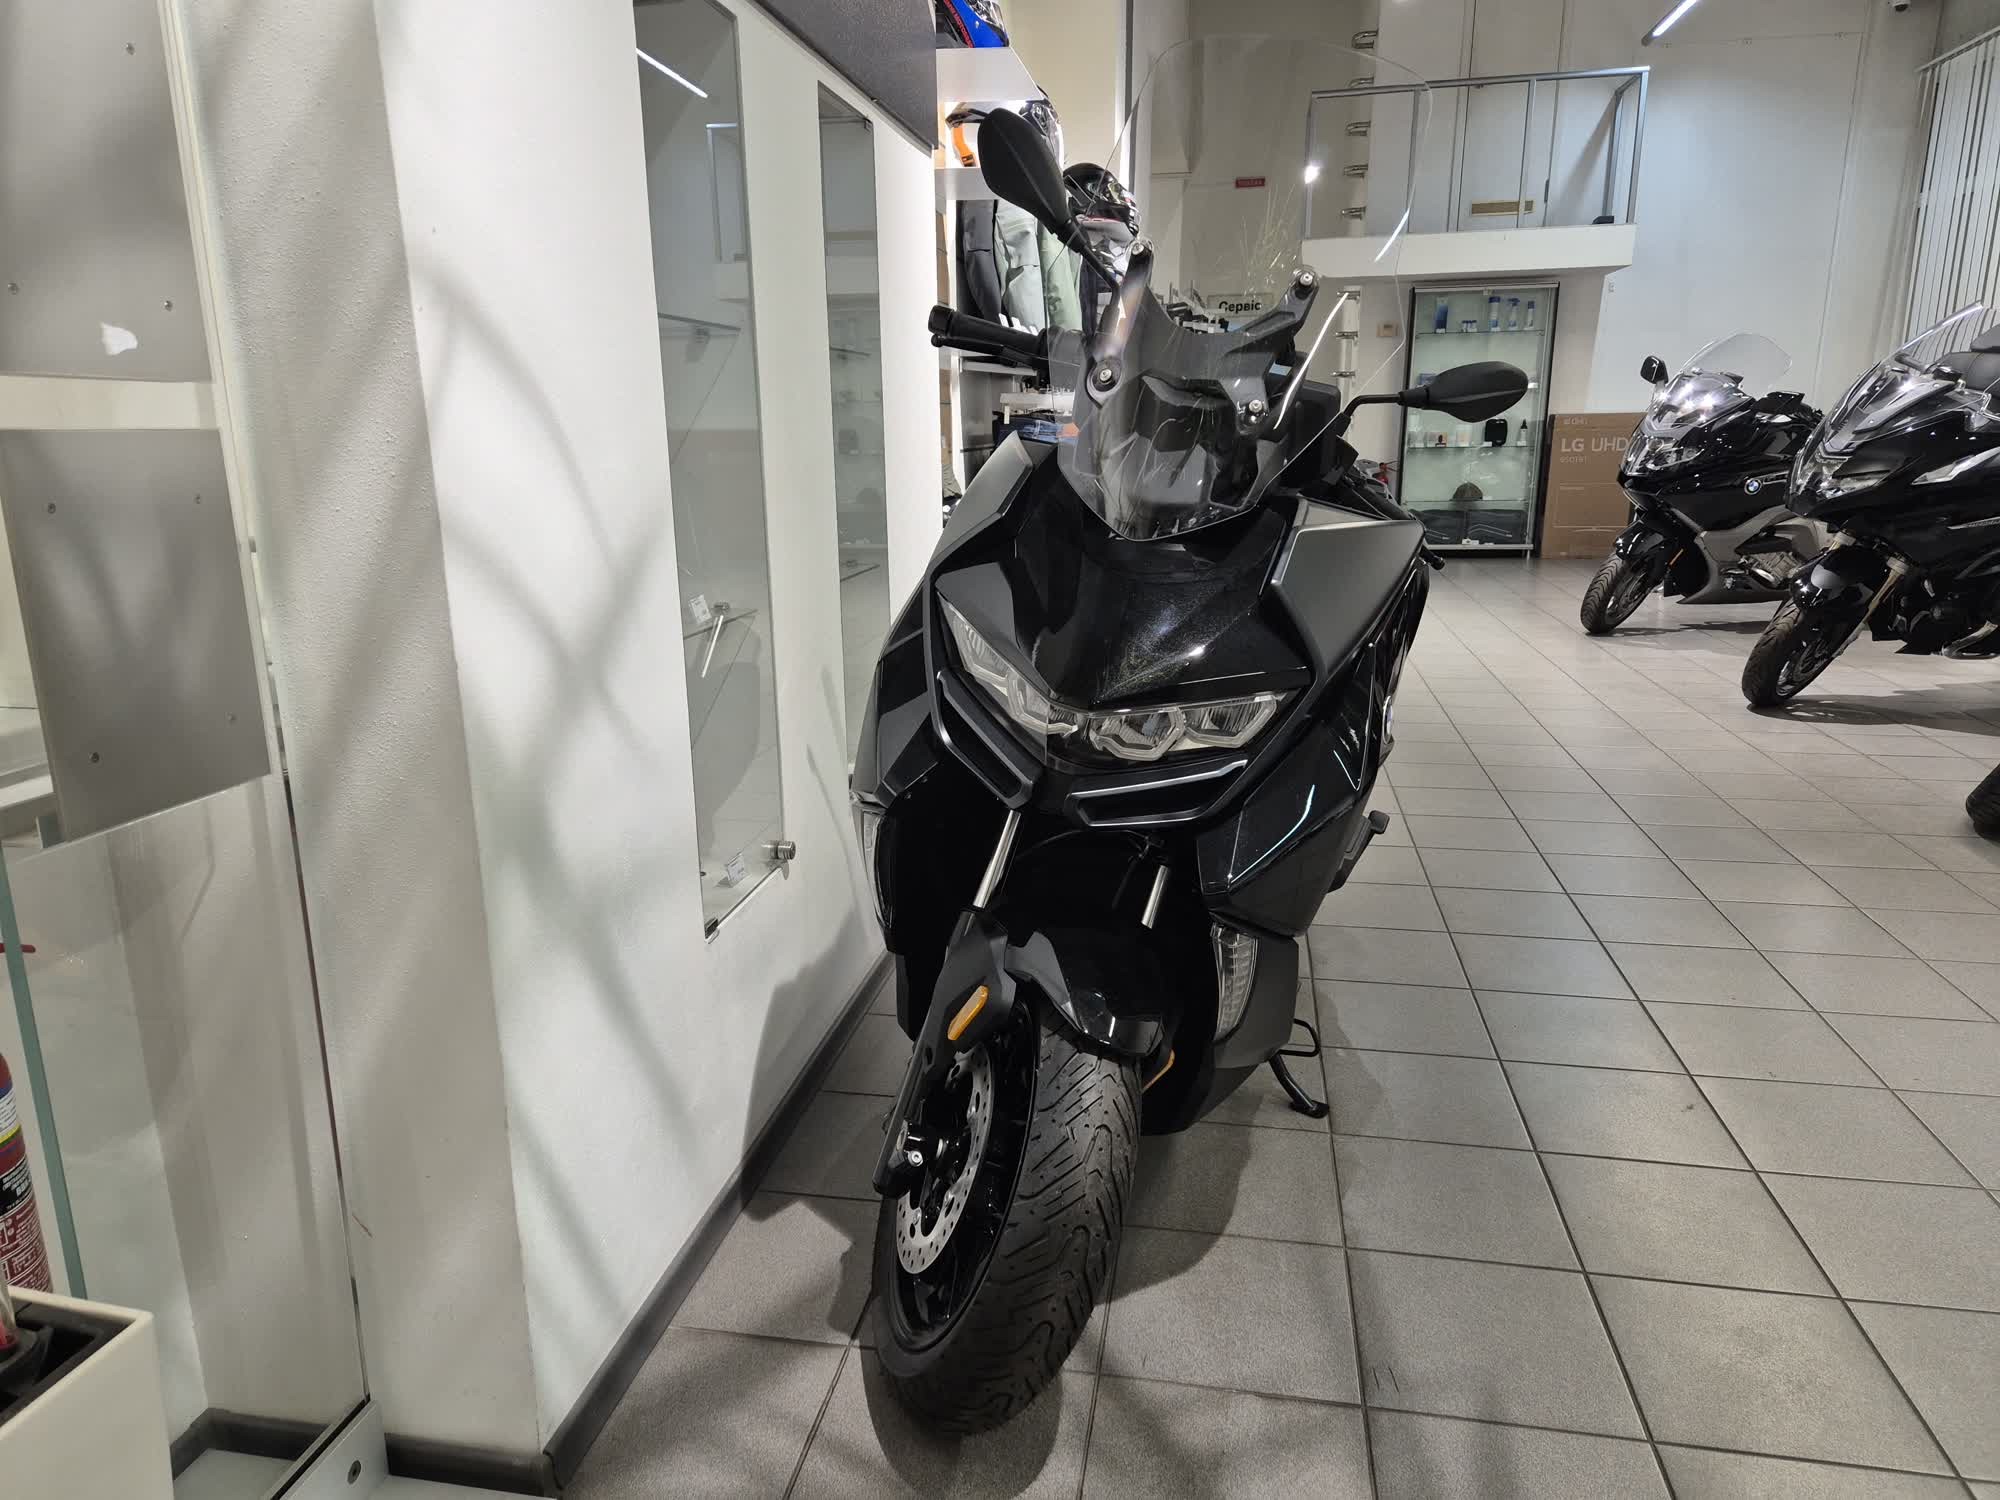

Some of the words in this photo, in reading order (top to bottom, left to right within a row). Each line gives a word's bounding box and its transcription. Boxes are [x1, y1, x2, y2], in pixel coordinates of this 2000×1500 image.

[1218, 300, 1262, 314] Сервіс
[1561, 438, 1585, 452] LG
[1591, 437, 1629, 452] UHD
